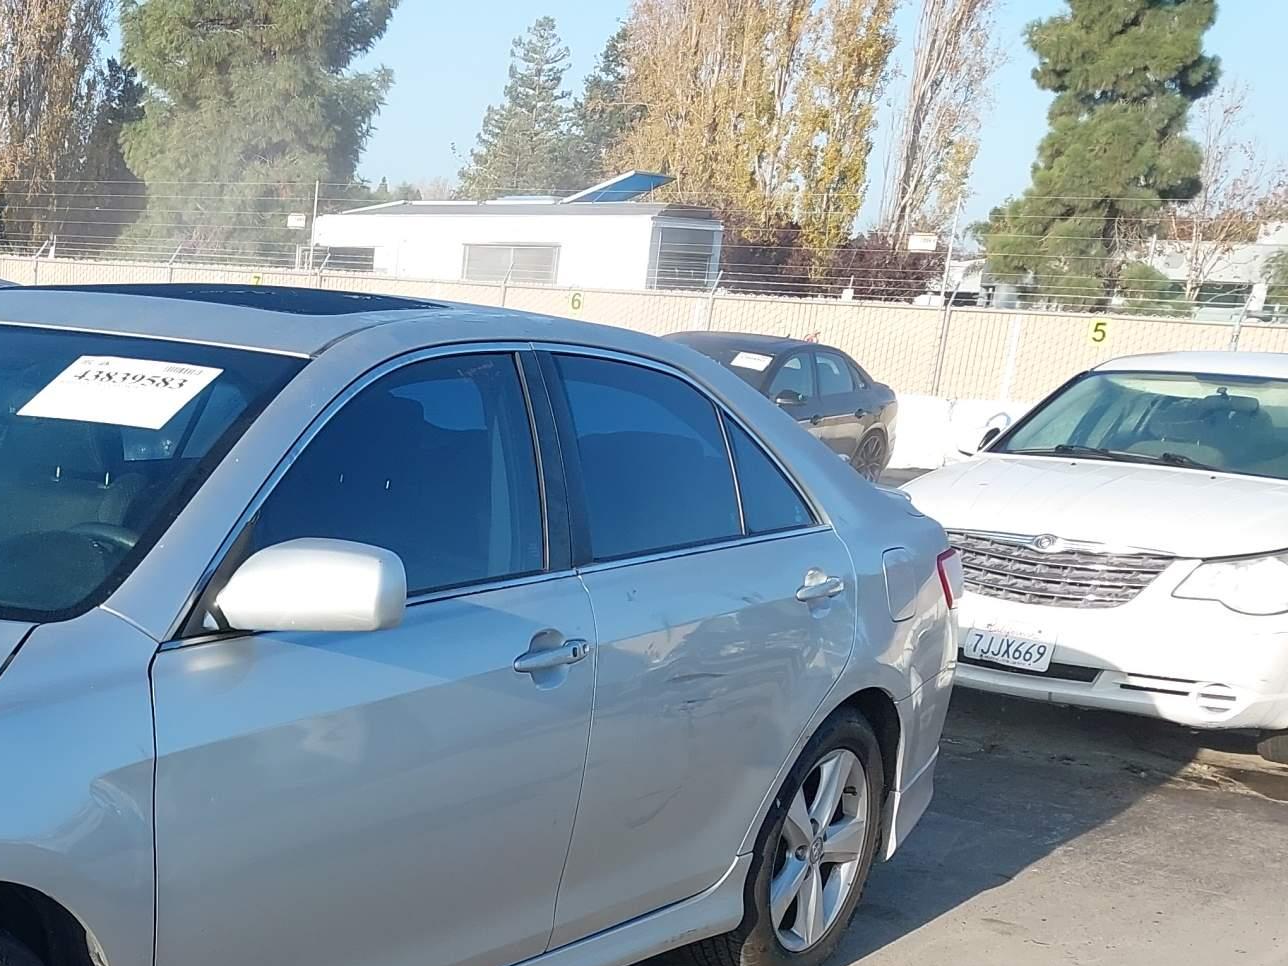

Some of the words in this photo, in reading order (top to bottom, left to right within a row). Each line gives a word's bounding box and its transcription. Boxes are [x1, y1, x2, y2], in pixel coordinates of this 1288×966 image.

[253, 275, 261, 287] 7
[571, 292, 582, 310] 6
[1092, 322, 1107, 342] 5
[73, 368, 188, 390] 43839583
[972, 632, 1047, 664] 7JJX669
